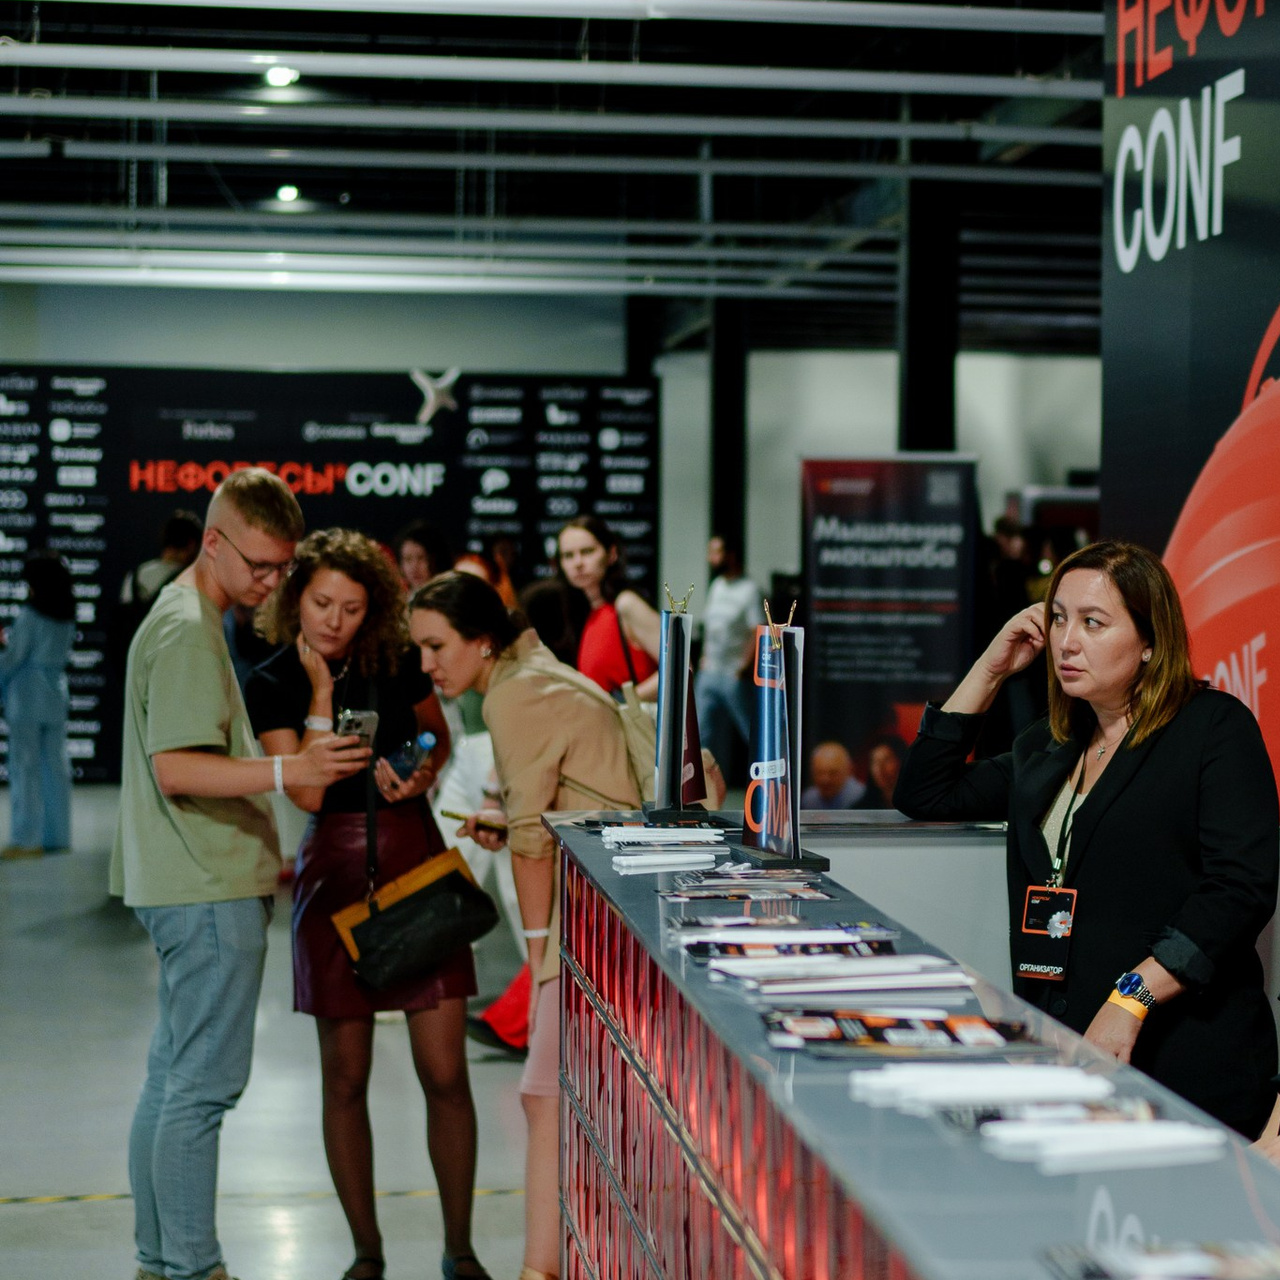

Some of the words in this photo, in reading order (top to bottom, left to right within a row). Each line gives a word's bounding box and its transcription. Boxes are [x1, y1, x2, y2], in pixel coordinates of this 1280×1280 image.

[1114, 69, 1245, 272] CONF
[130, 460, 346, 493] НЕФОСЫ
[345, 461, 446, 496] CONF
[1020, 963, 1063, 974] ОРГАНИЗАТОР
